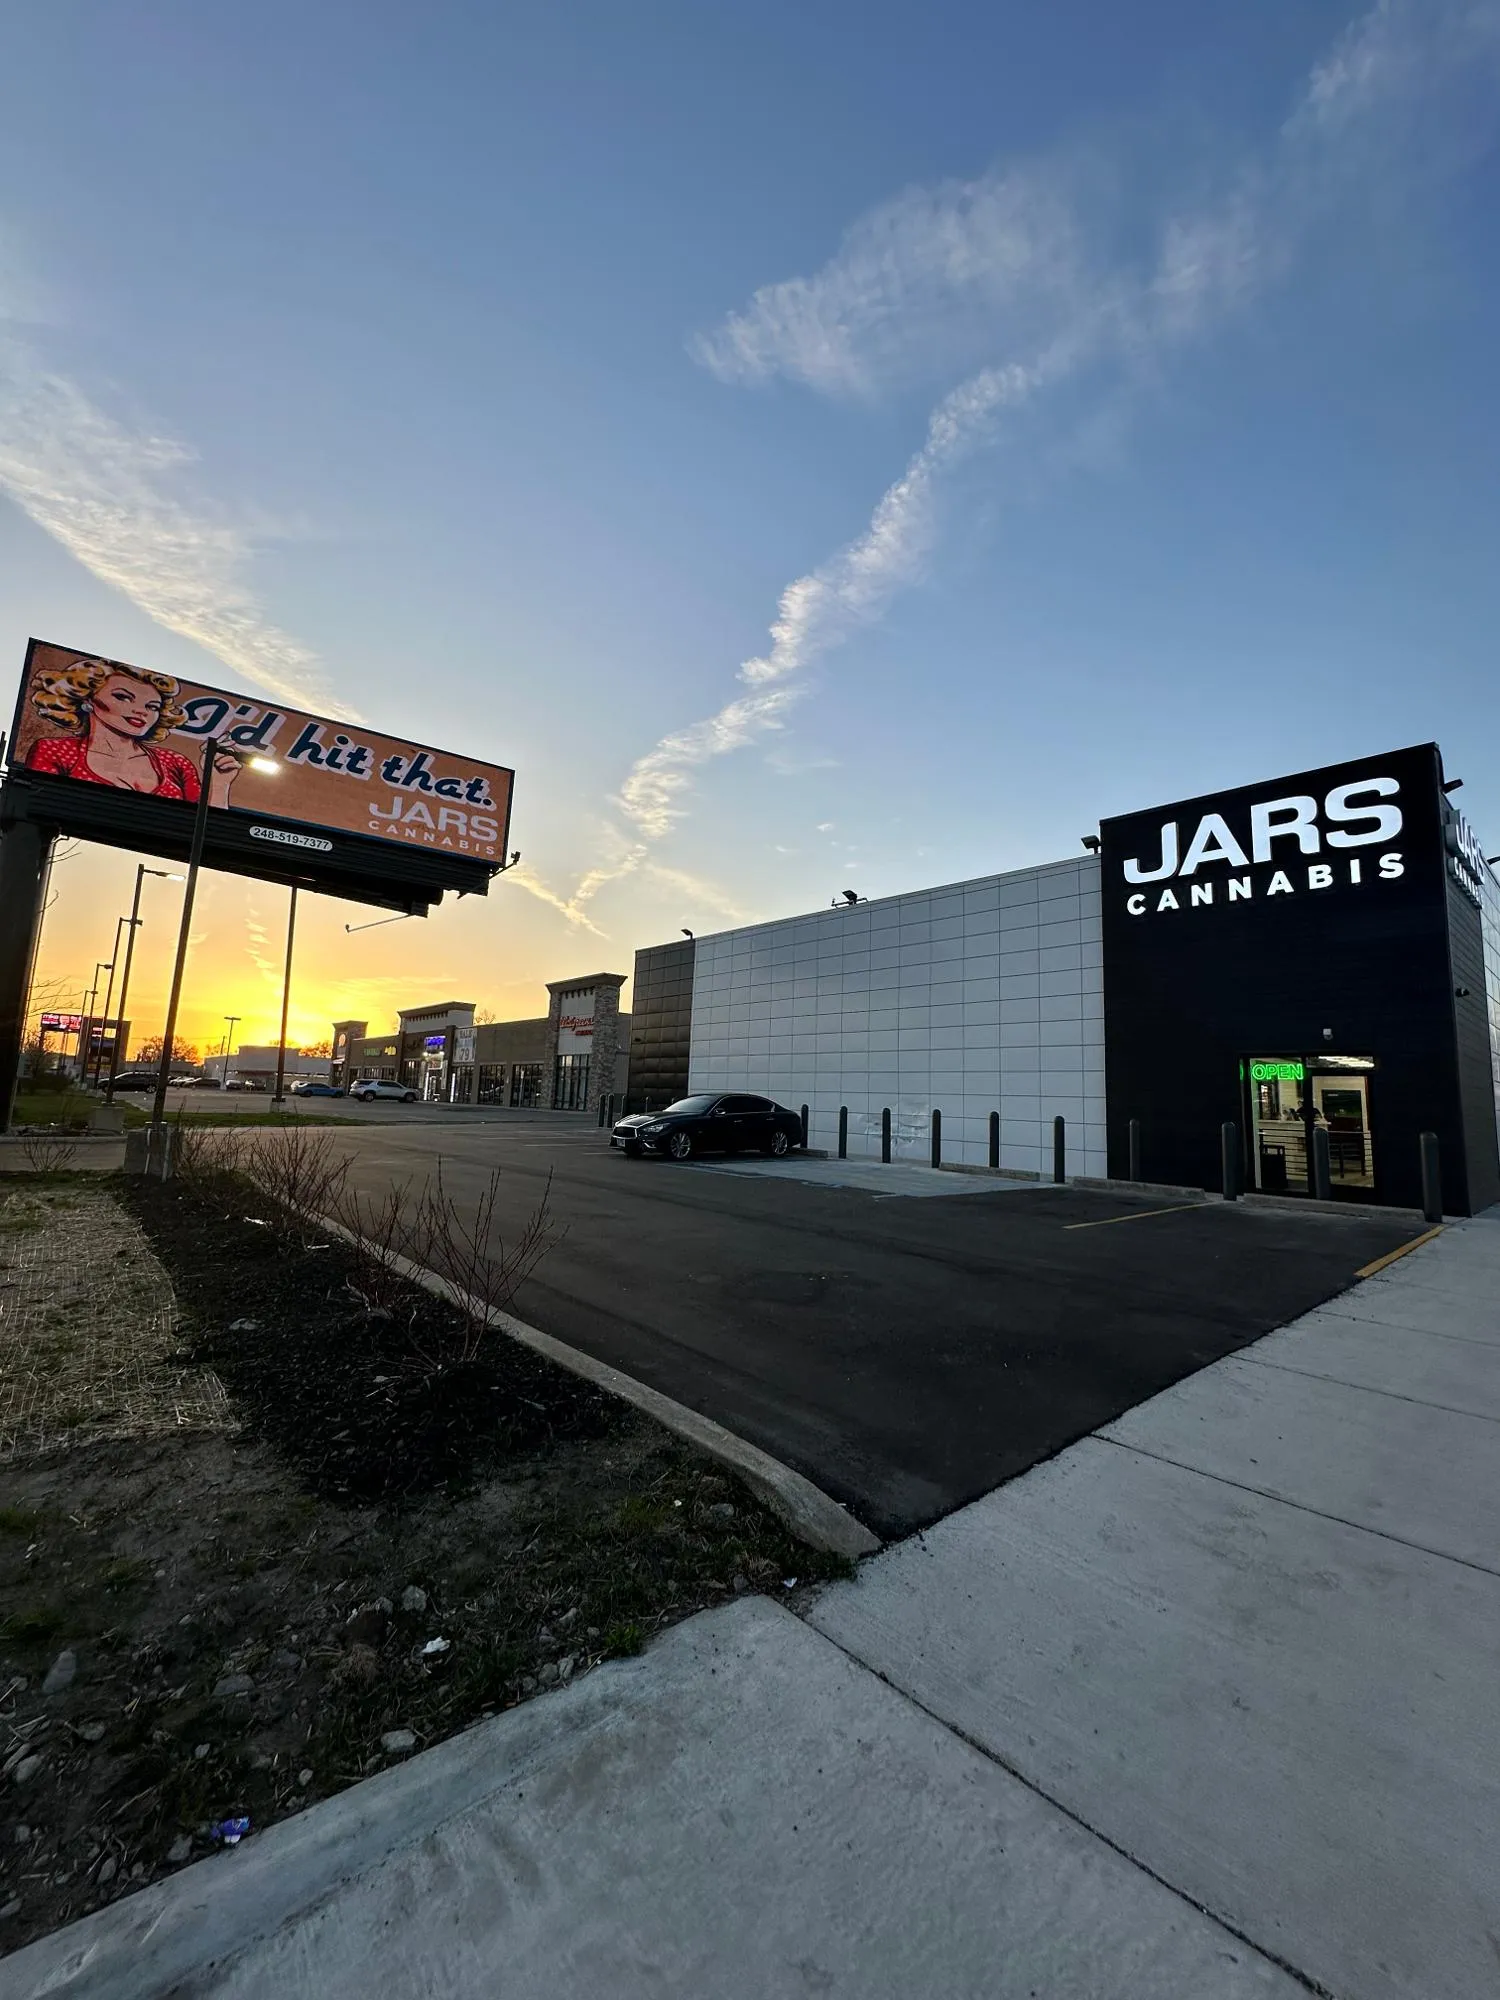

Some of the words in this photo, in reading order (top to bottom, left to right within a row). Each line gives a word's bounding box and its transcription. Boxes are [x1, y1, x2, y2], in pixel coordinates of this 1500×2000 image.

[173, 696, 287, 754] I'd
[287, 721, 373, 777] hit
[380, 751, 496, 810] that.
[253, 827, 330, 850] 248-519-7377
[368, 820, 496, 856] CANNABIS
[369, 796, 498, 842] JARS
[1122, 777, 1404, 884] JARS
[1126, 853, 1406, 916] CANNABIS
[1251, 1063, 1304, 1080] OPEN
